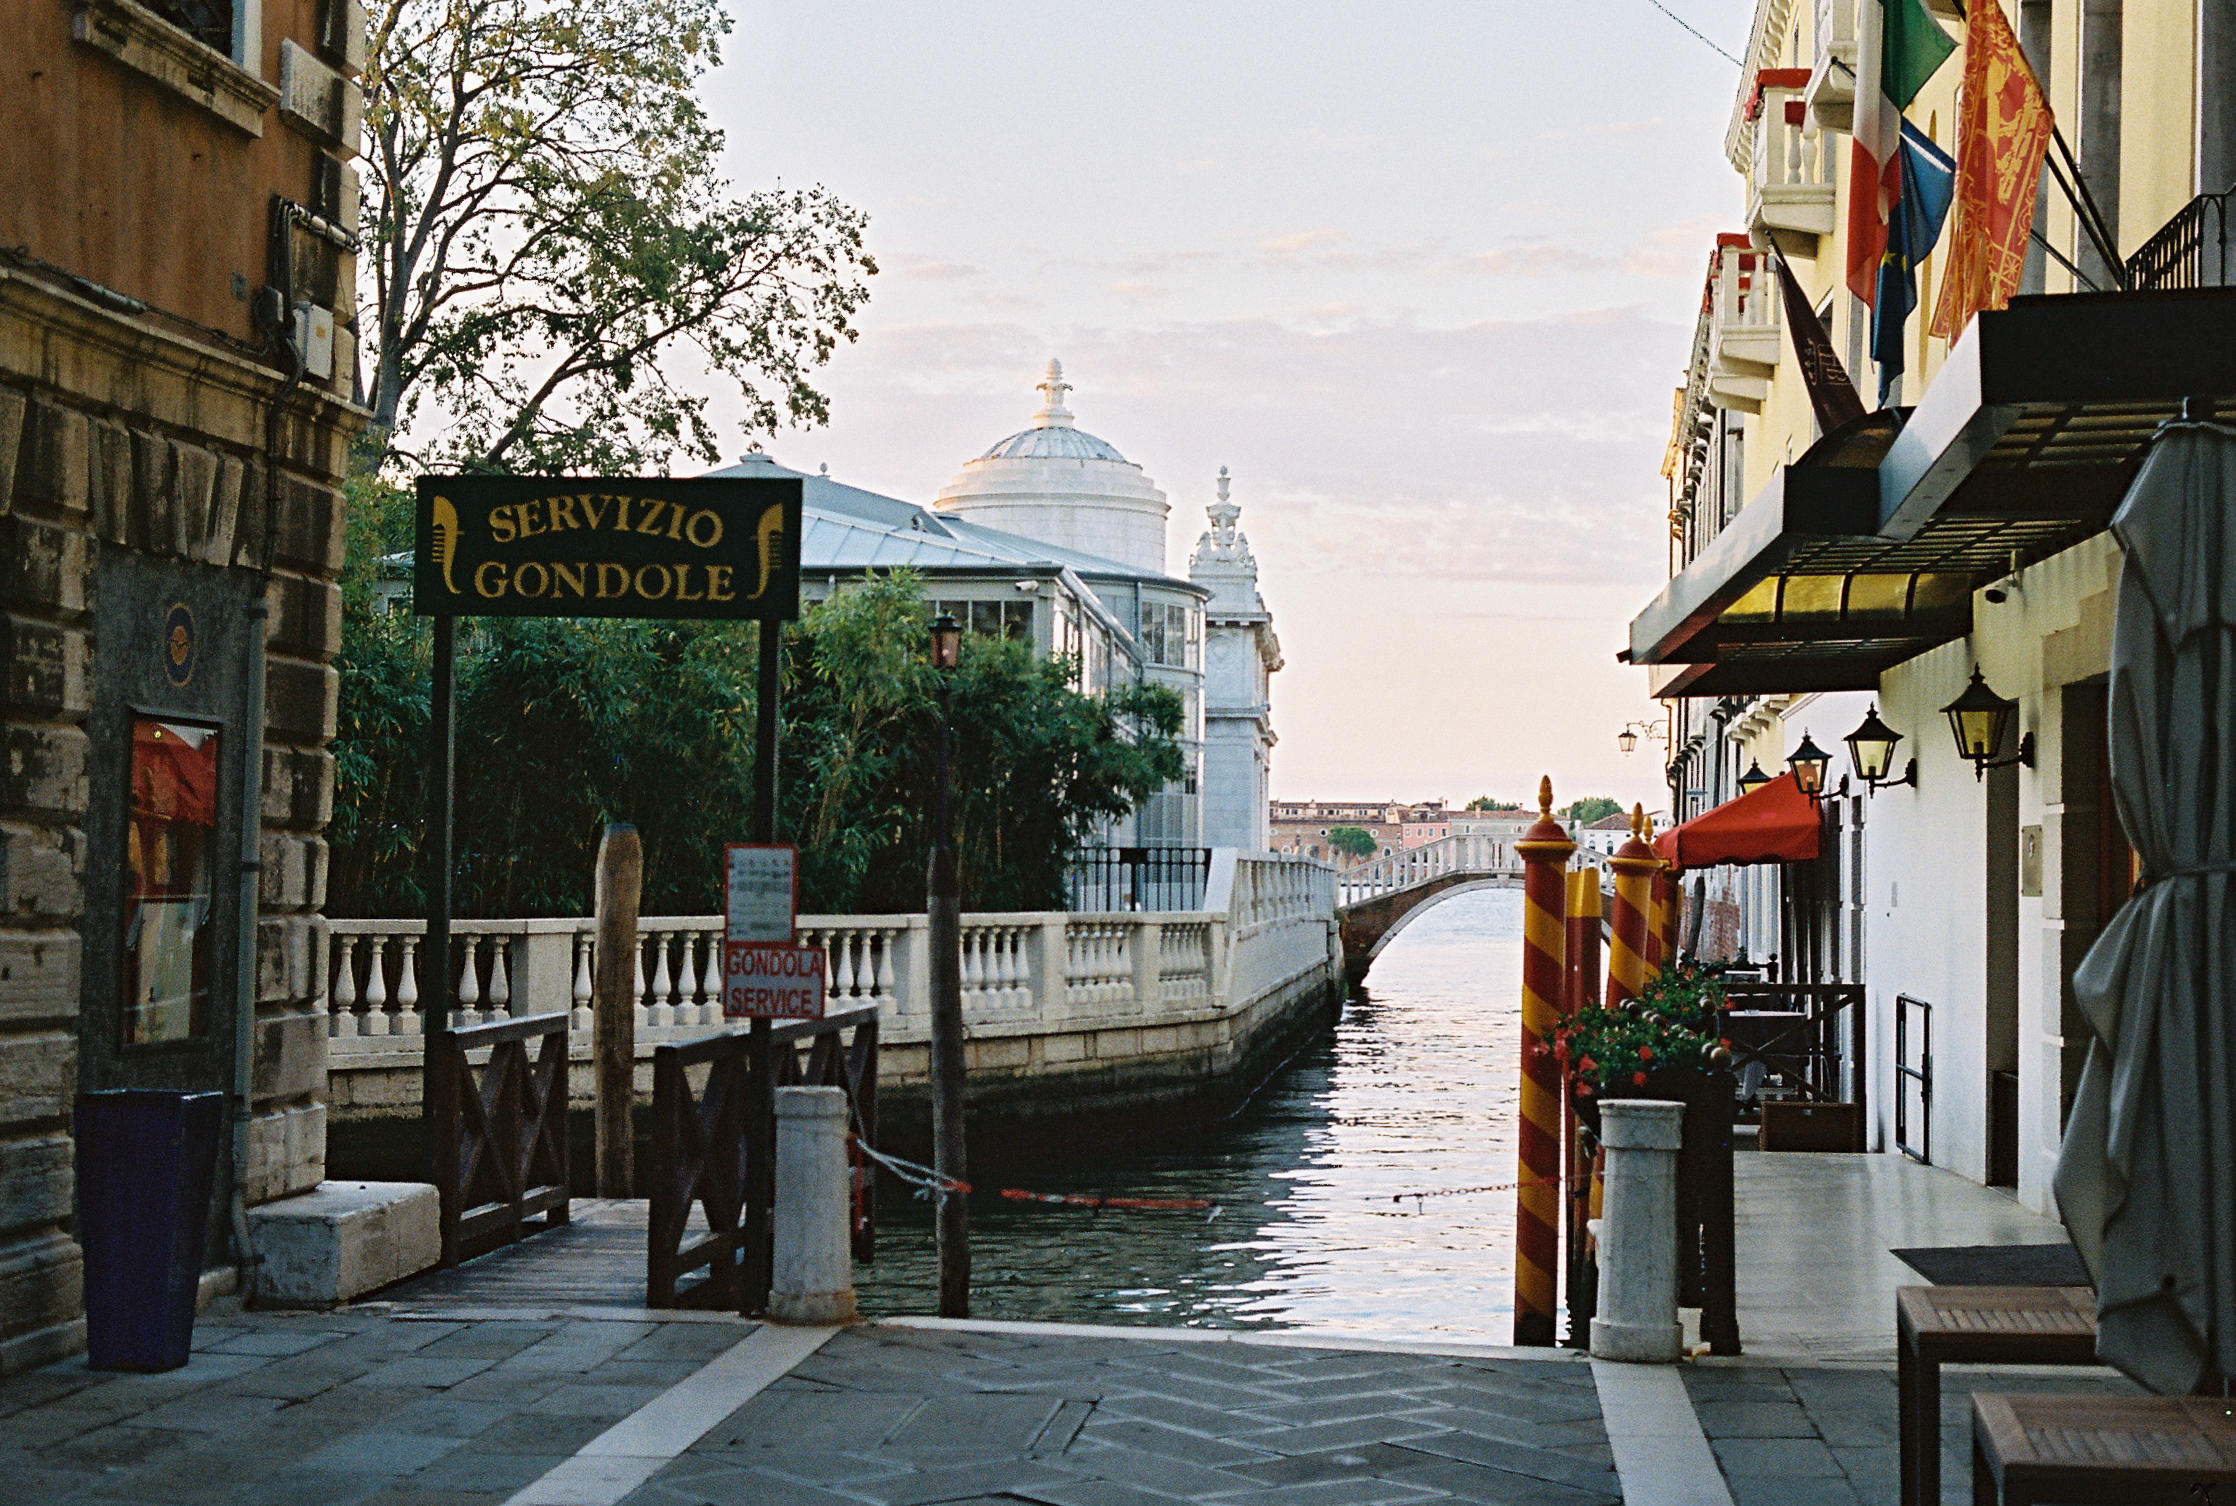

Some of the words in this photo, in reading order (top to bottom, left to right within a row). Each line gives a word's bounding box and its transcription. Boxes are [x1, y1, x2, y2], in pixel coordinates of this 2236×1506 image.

[488, 493, 724, 548] SERVIZIO
[474, 560, 737, 601] GONDOLE
[727, 950, 822, 978] GONDOLA
[731, 987, 813, 1016] SERVICE
